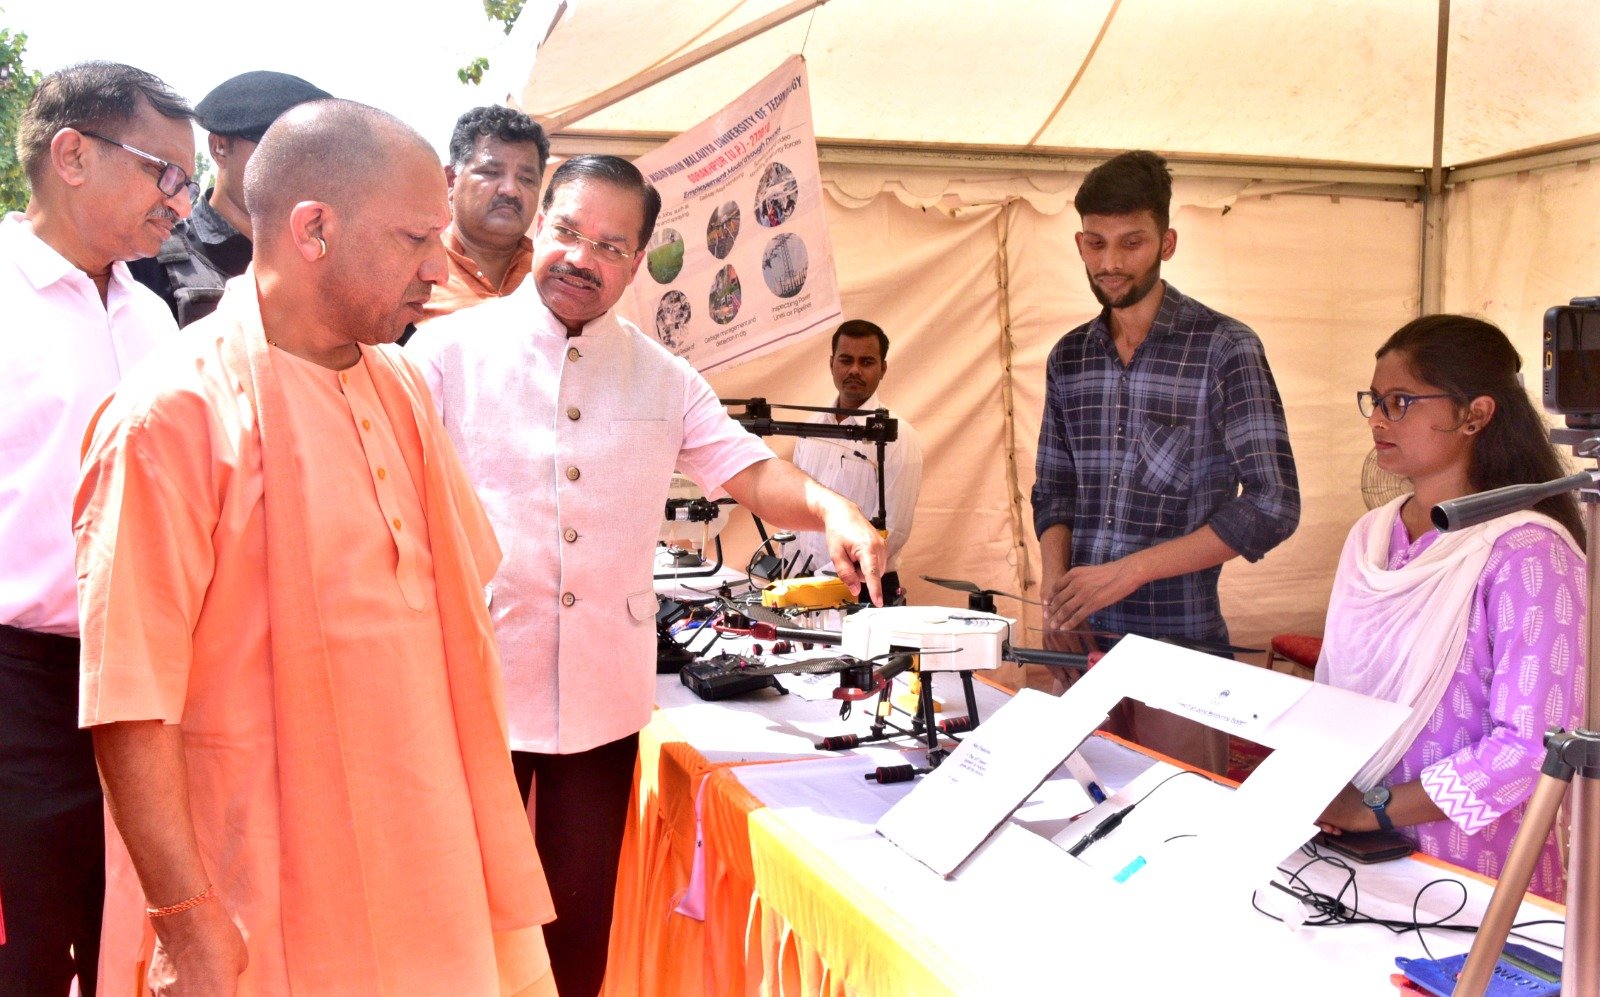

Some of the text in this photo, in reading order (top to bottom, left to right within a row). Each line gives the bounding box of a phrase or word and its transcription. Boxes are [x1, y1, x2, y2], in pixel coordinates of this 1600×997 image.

[682, 143, 717, 168] MALAVIYA
[713, 115, 757, 148] UNIVERSITY
[754, 107, 767, 119] OF
[765, 75, 802, 113] TECHNGY
[687, 155, 729, 183] GORAKHPUR
